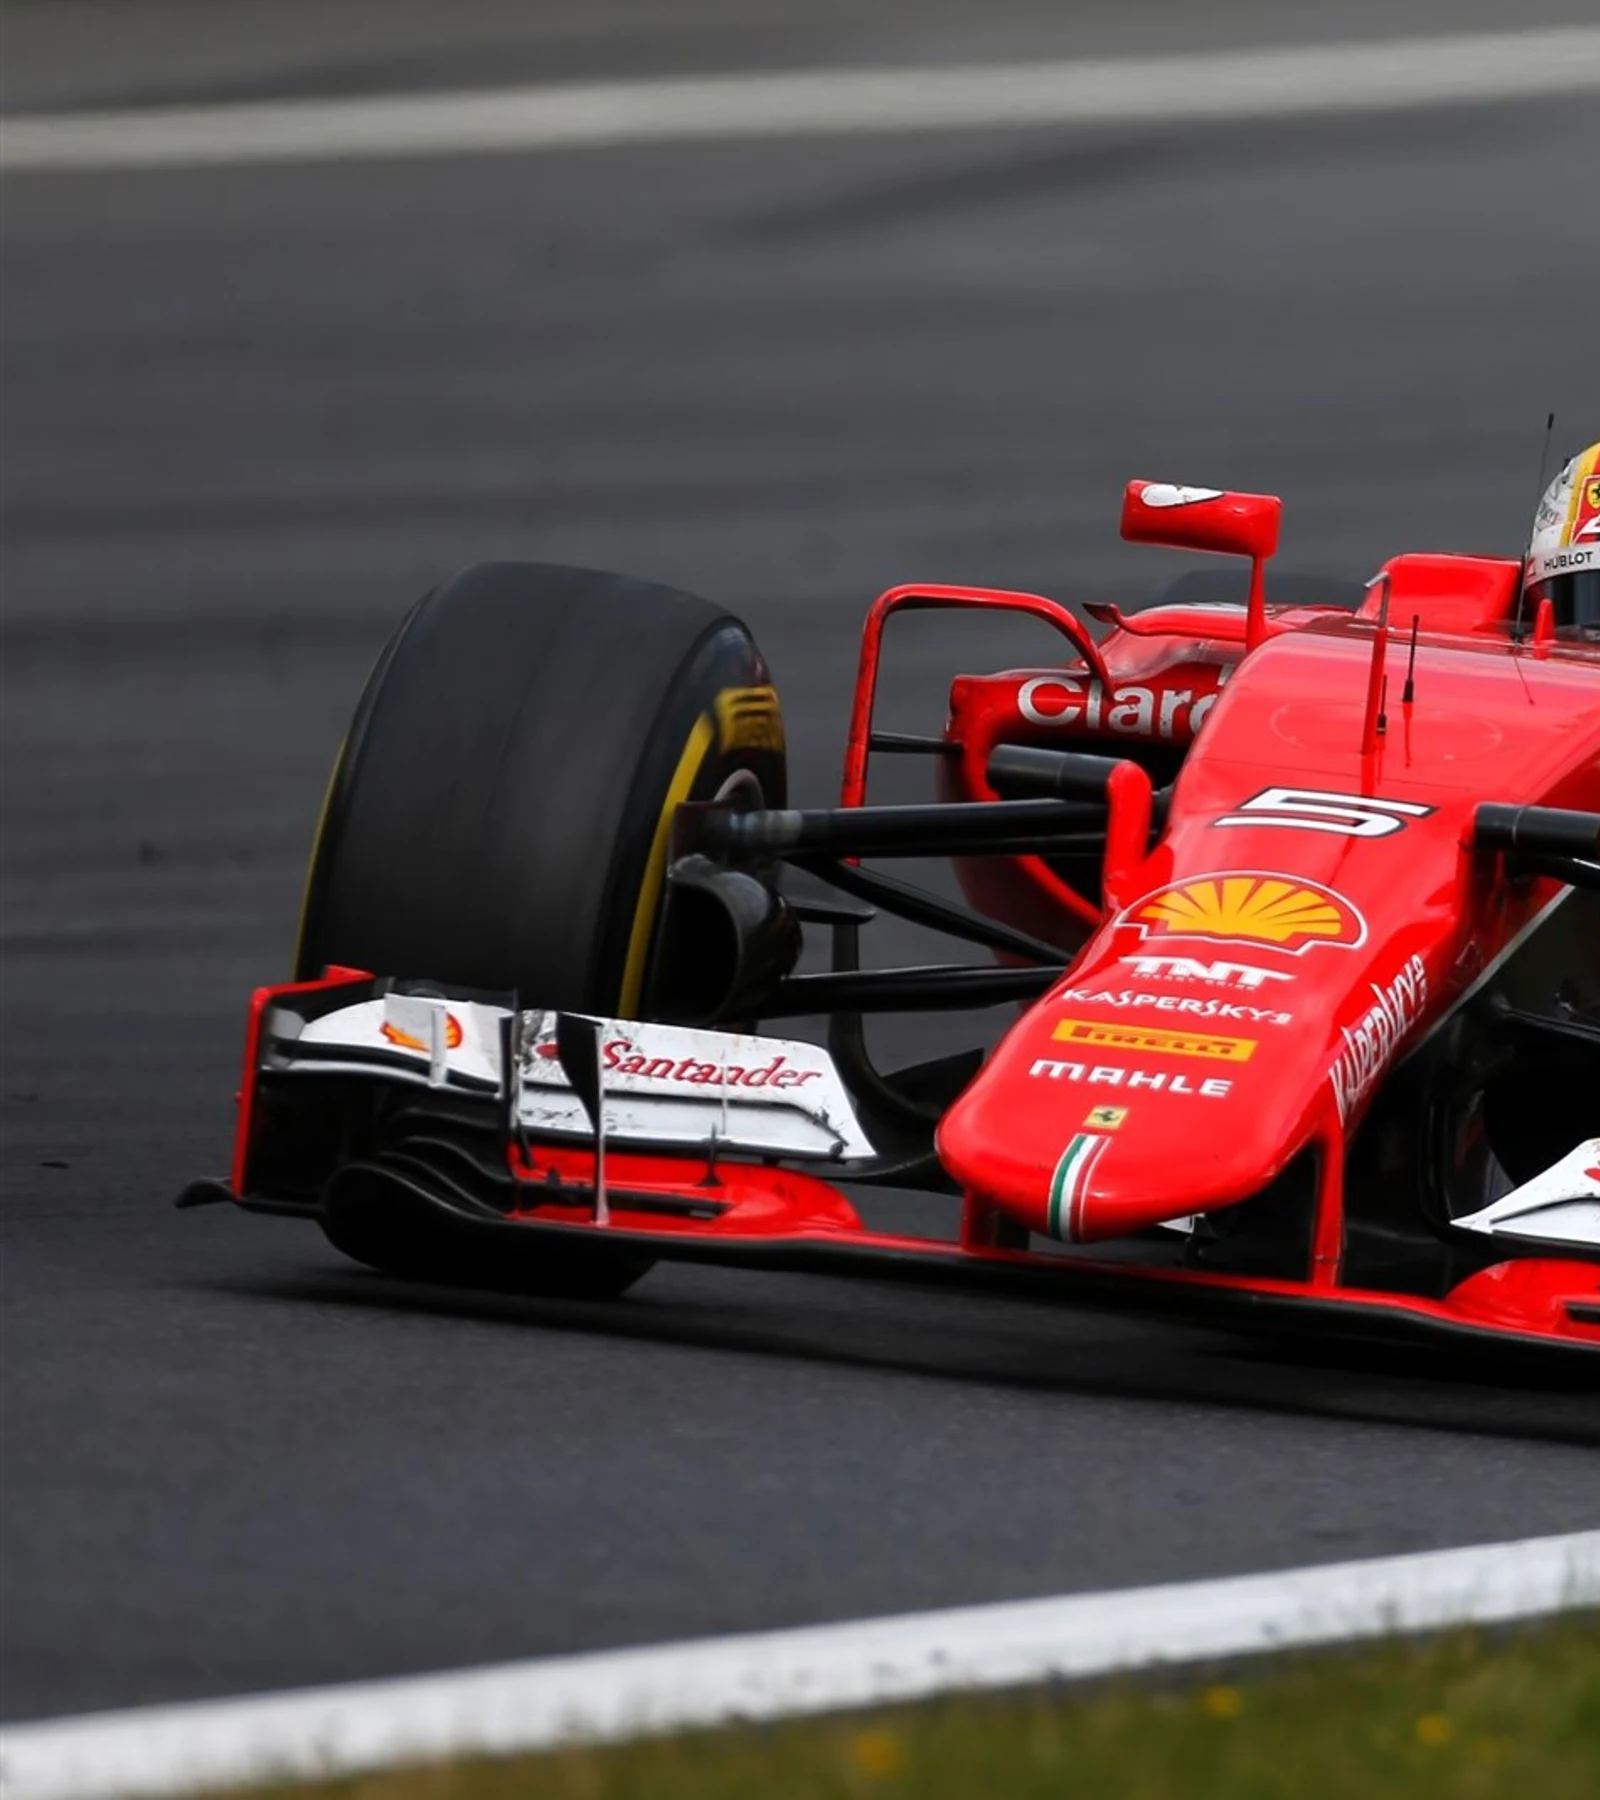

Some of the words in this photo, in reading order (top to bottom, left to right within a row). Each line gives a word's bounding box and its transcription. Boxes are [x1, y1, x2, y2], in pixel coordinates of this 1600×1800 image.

[1543, 550, 1594, 572] HUBLOT
[1209, 786, 1440, 838] 5
[1118, 955, 1297, 988] TNT
[1062, 988, 1275, 1021] KASPERSKY
[1071, 1023, 1237, 1055] PIRELLI
[601, 1039, 823, 1089] Santander
[1029, 1058, 1235, 1099] MAHLE
